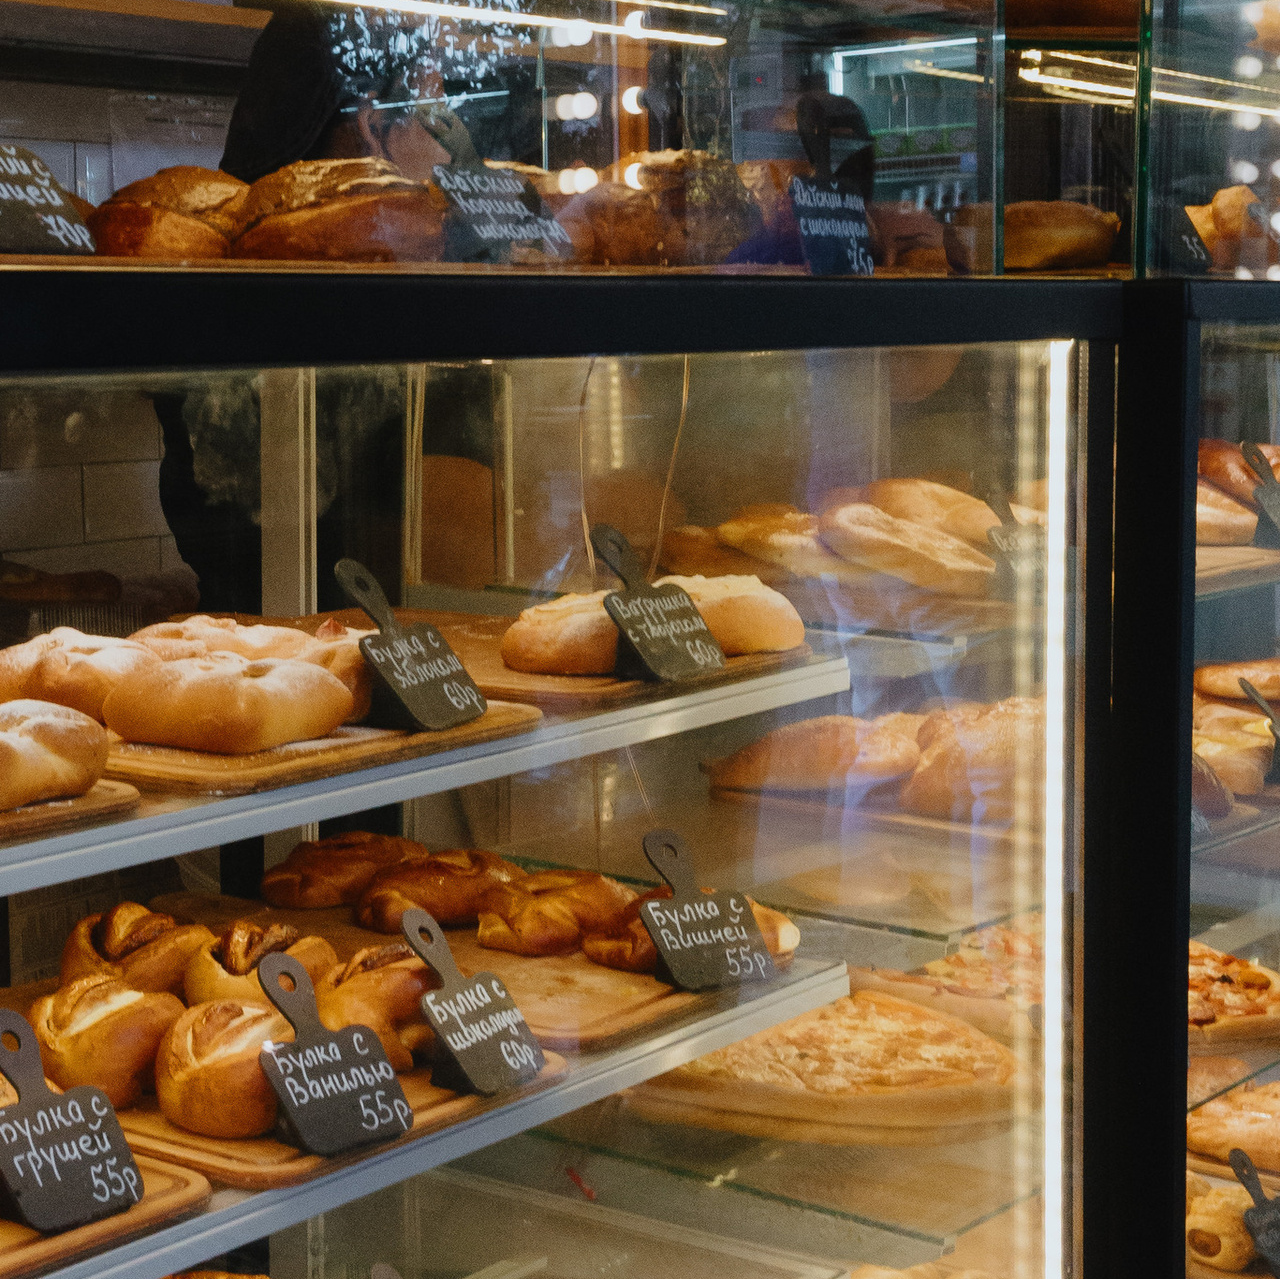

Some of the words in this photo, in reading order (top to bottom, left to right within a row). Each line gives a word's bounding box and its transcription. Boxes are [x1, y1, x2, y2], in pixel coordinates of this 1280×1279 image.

[611, 593, 694, 622] Ватрушка
[648, 901, 720, 936] Булка
[730, 897, 744, 914] с
[660, 915, 749, 951] Вишней
[426, 983, 492, 1033] Булка
[491, 979, 506, 999] с
[269, 1042, 342, 1083] Булка
[352, 1032, 369, 1056] с
[91, 1095, 108, 1117] с
[284, 1061, 395, 1107] Ванилью
[13, 1118, 111, 1188] грушей
[90, 1156, 139, 1202] 55р
